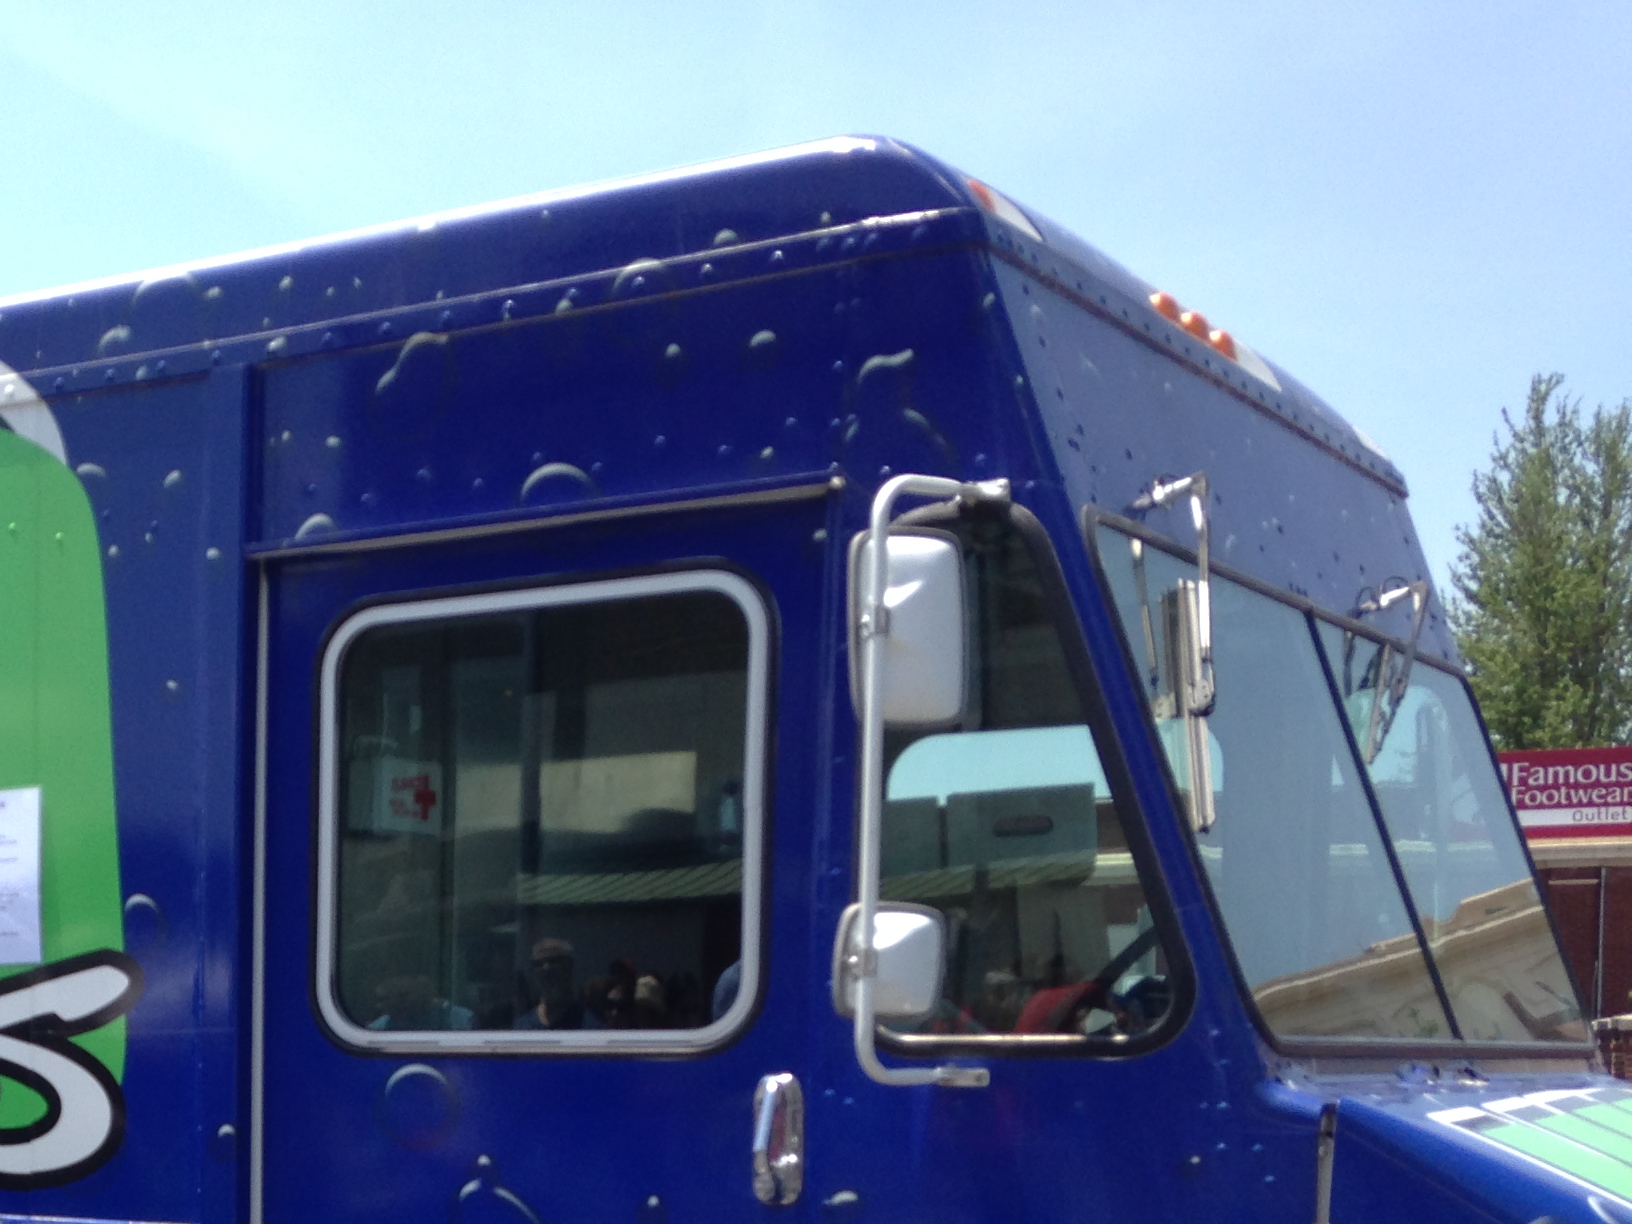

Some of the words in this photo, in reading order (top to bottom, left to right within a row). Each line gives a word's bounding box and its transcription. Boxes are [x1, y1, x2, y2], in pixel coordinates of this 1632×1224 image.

[1512, 761, 1632, 787] Famous
[1511, 786, 1632, 807] Footwear
[1572, 808, 1629, 822] Outlet
